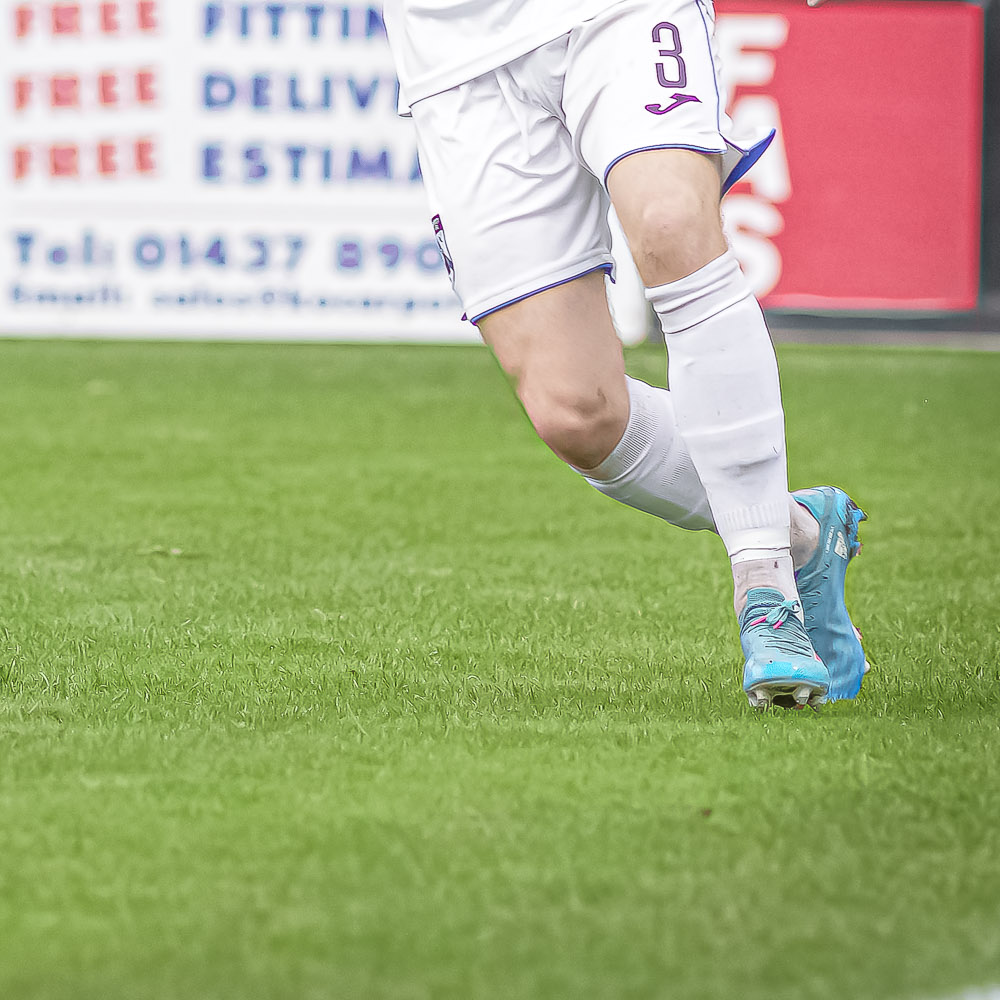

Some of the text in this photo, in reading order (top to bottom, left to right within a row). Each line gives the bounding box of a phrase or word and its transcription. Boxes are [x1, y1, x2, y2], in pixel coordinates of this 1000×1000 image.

[652, 21, 686, 88] 3
[12, 69, 399, 111] FREE DELIV
[11, 140, 157, 180] FREE
